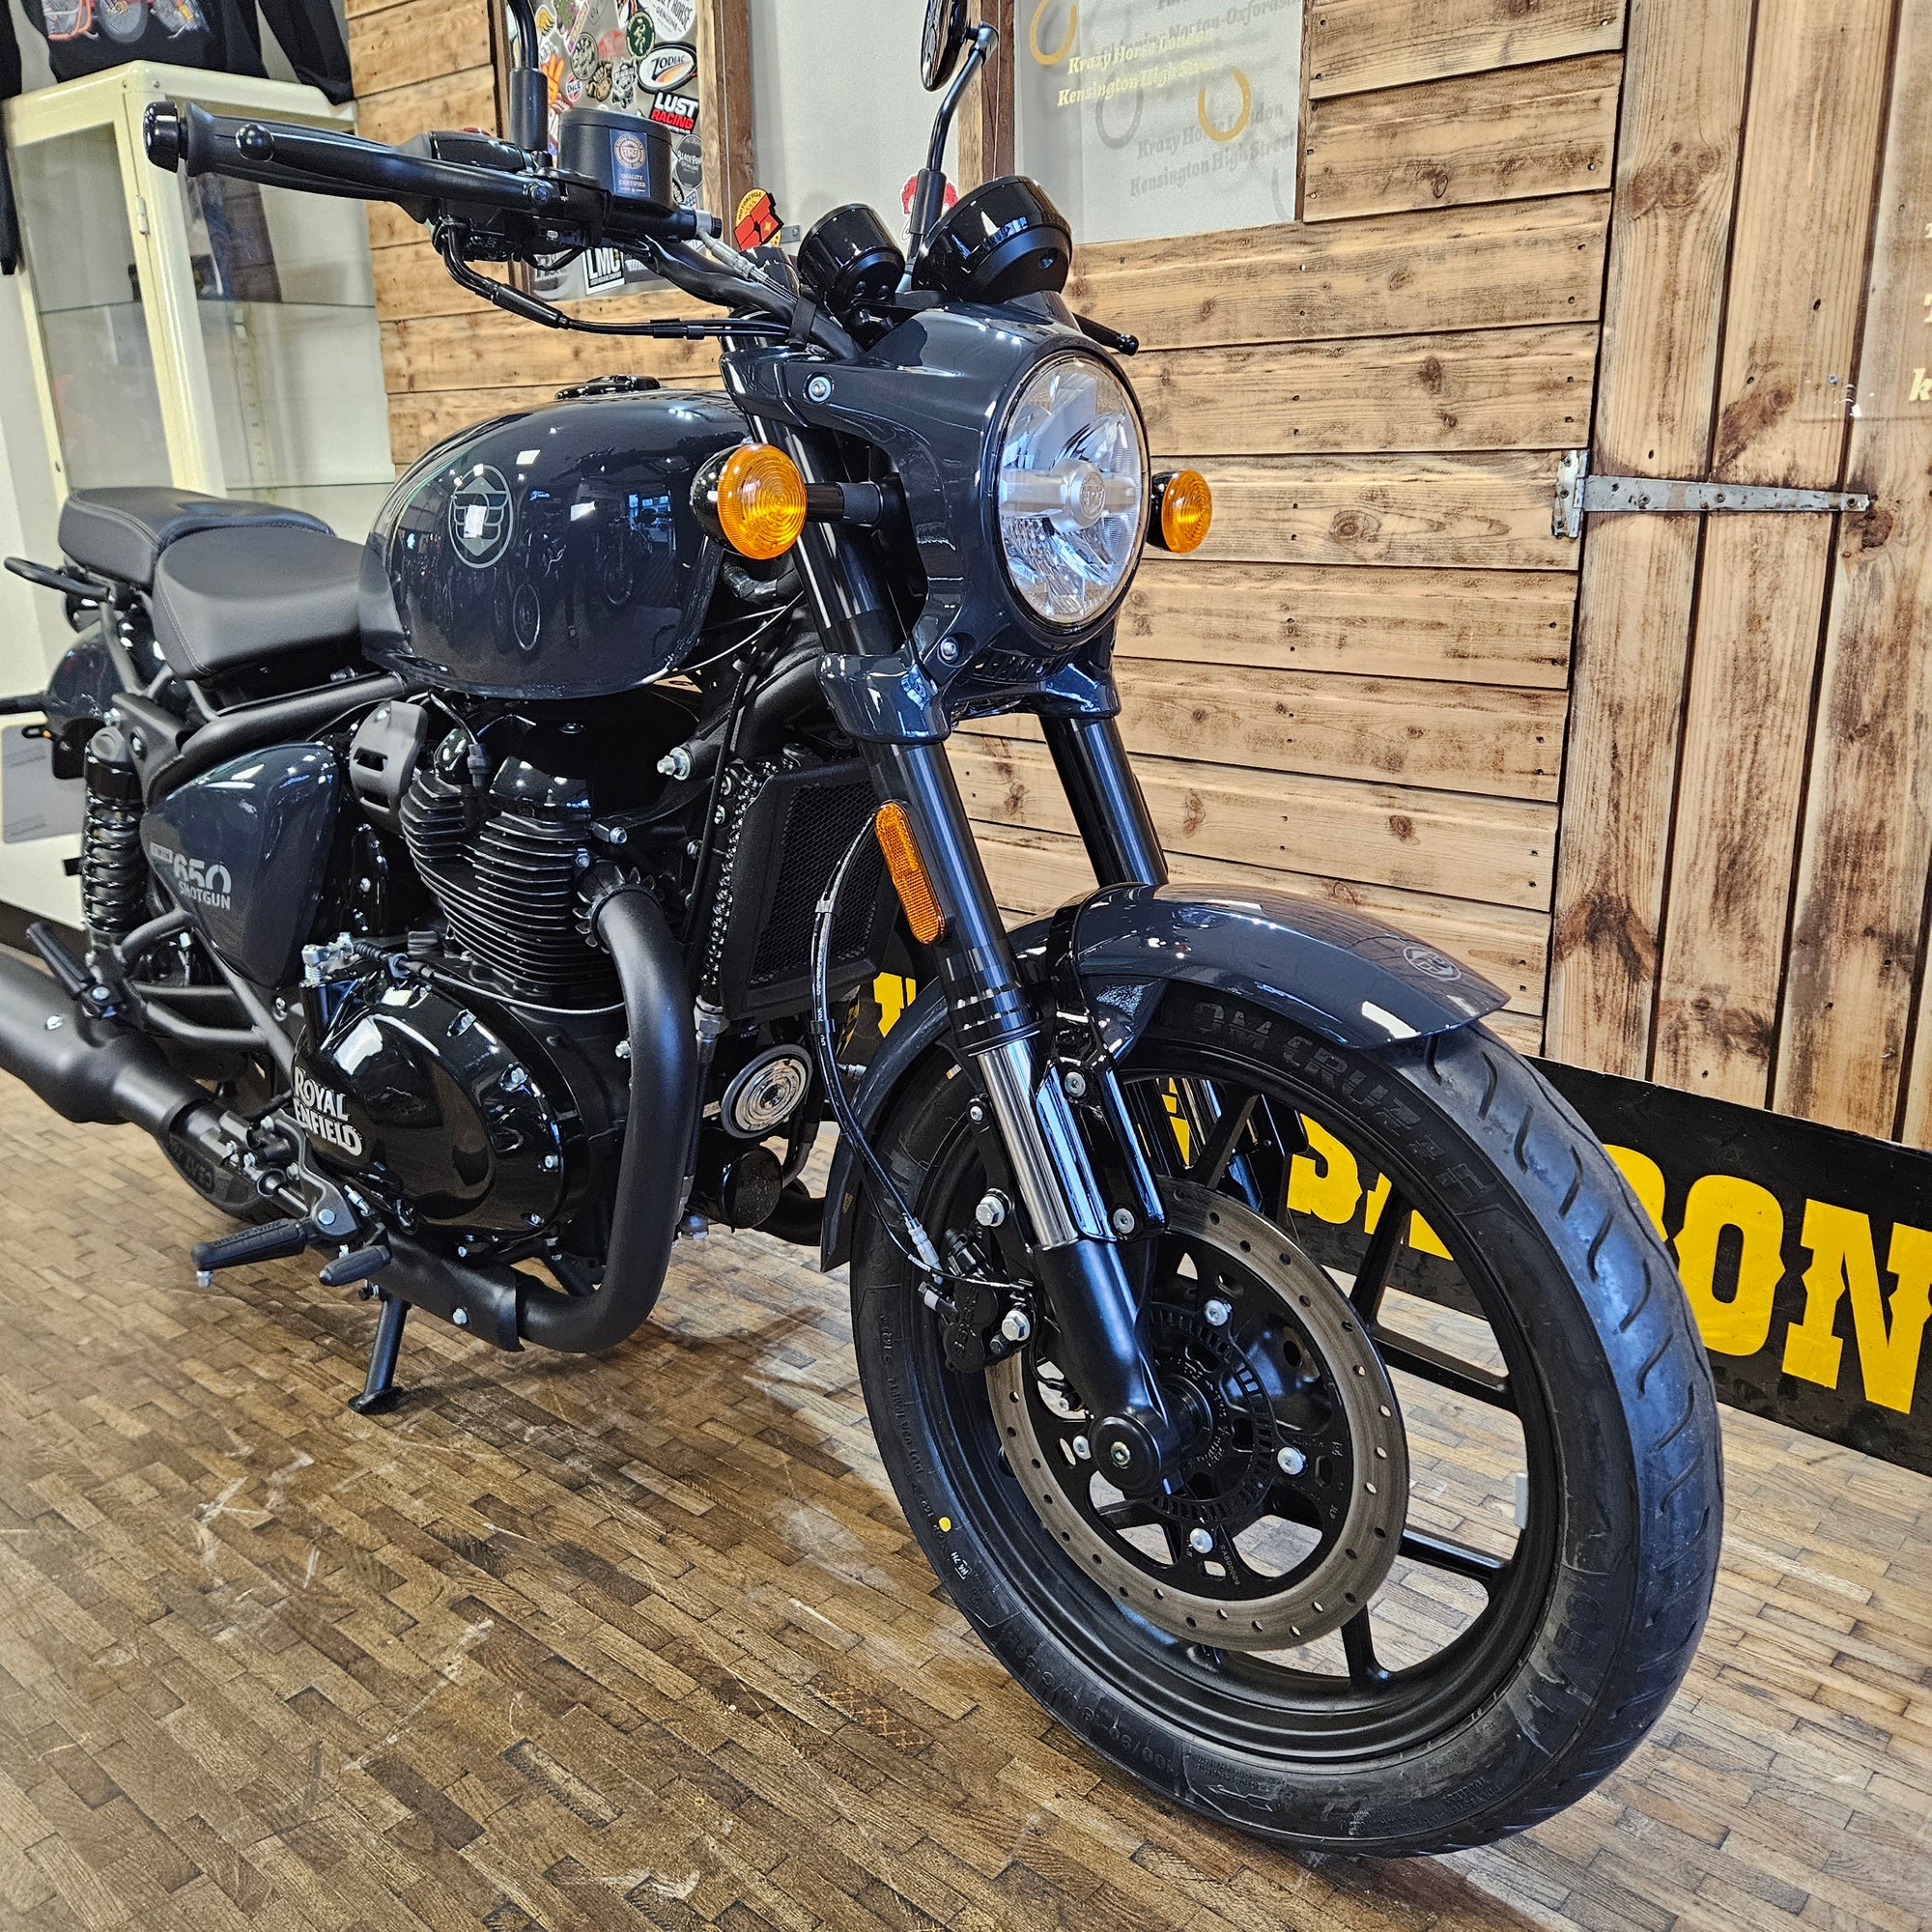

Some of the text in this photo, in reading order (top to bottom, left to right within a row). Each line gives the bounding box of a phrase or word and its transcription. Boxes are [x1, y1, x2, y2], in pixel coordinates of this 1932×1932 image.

[651, 55, 686, 81] ZODIAC
[1067, 46, 1113, 75] Krazy
[654, 92, 699, 118] LUST
[1057, 74, 1140, 107] Kensington
[650, 108, 695, 130] RACING
[1129, 158, 1209, 197] Kensington
[585, 246, 621, 280] LMC
[174, 853, 232, 895] 650
[178, 880, 231, 910] SHOTGUN
[294, 1065, 351, 1122] ROYAL
[293, 1097, 363, 1157] ENFIELD
